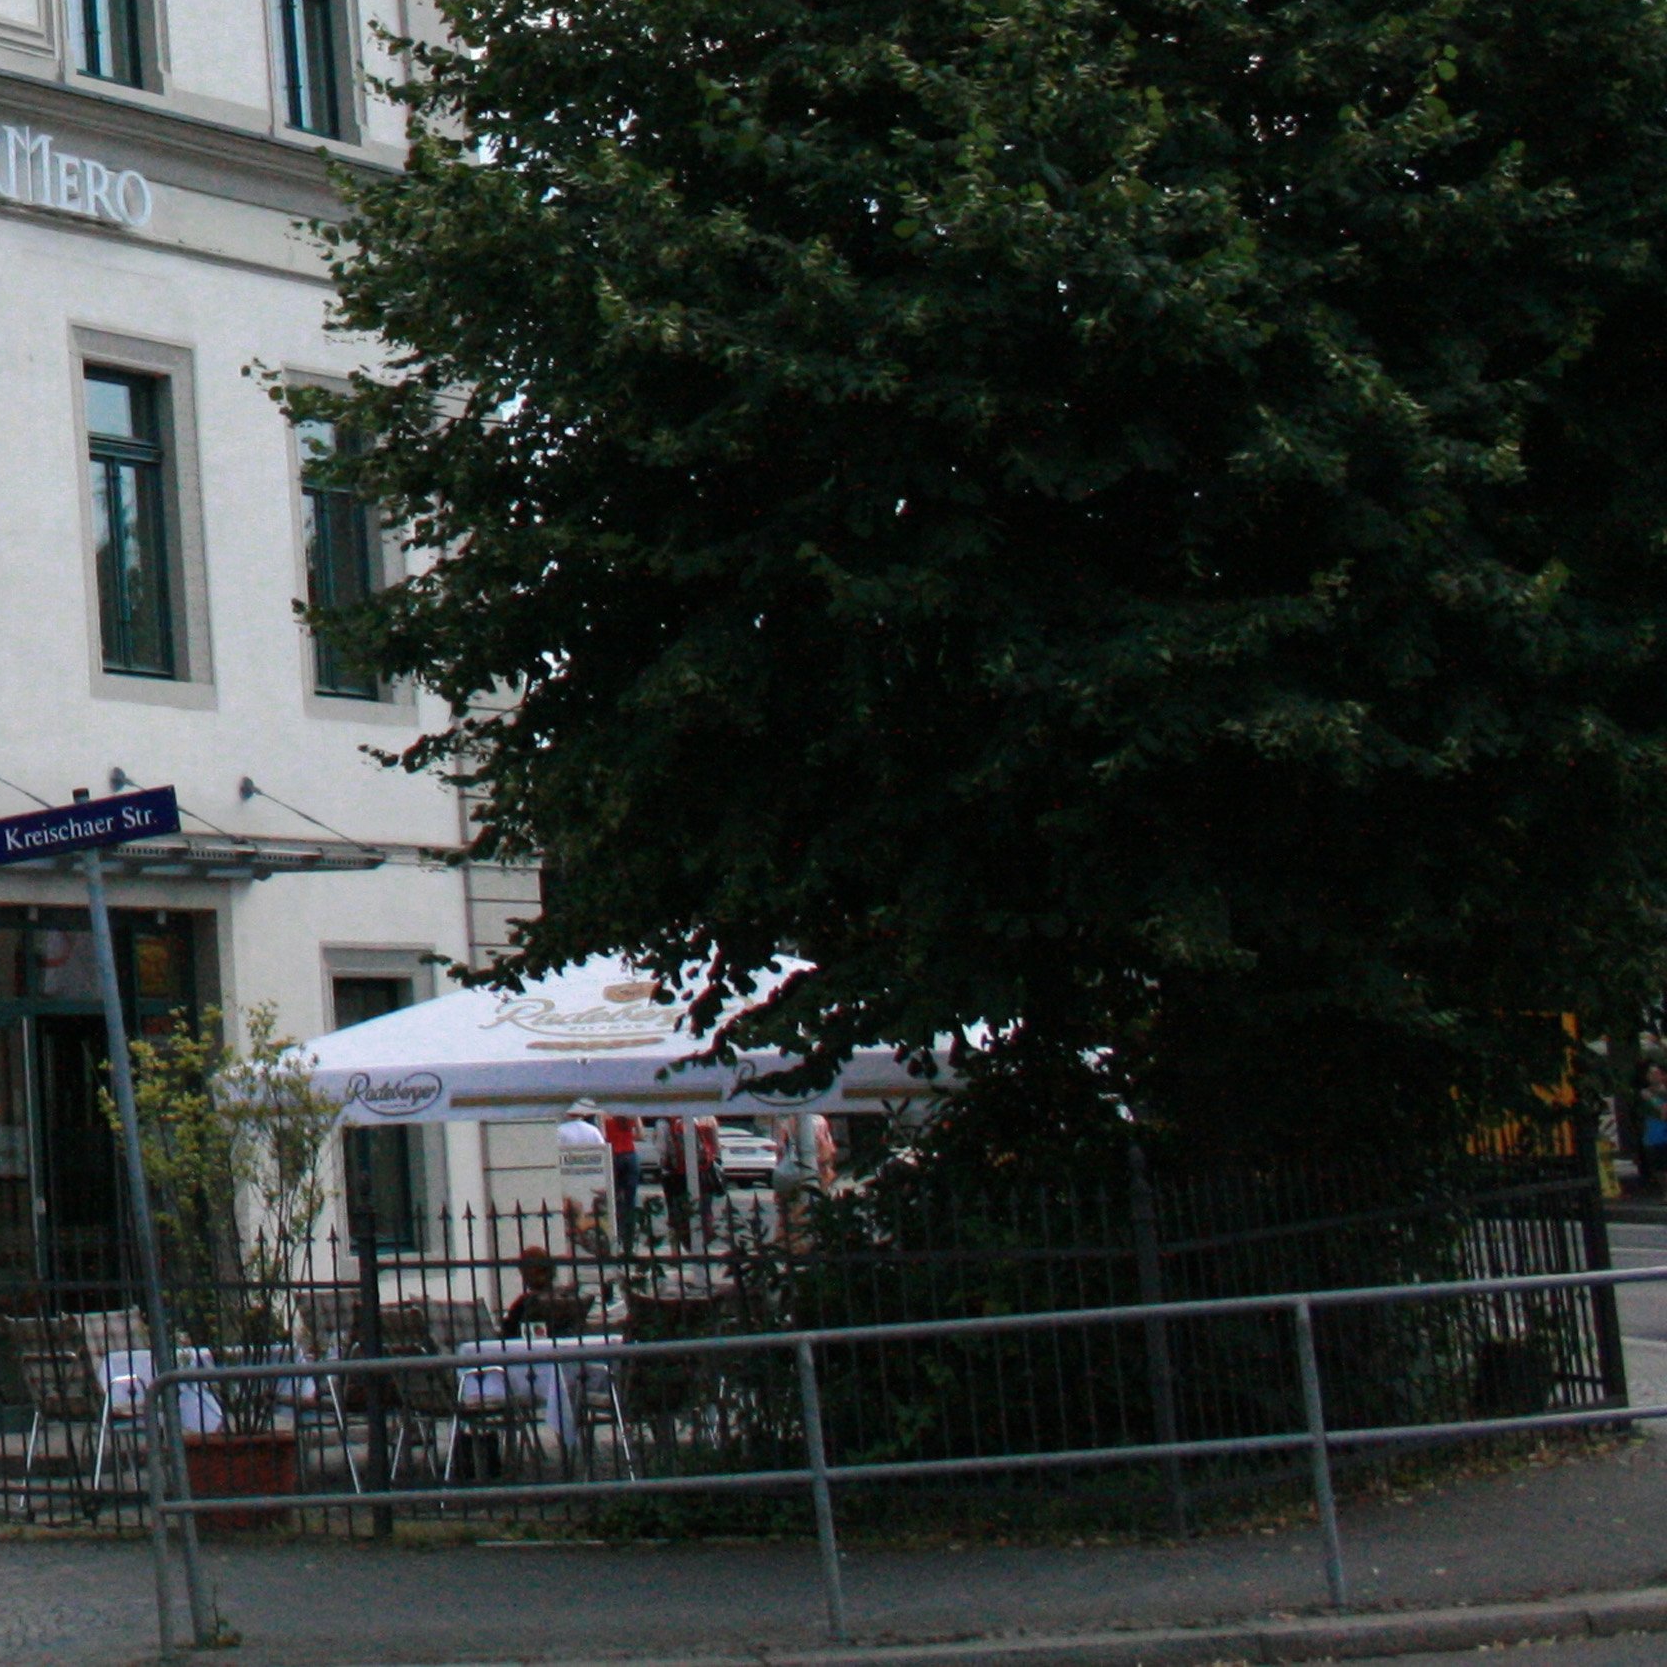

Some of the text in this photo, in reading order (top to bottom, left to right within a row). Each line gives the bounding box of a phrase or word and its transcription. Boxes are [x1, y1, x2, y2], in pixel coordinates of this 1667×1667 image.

[4, 805, 158, 852] Kreischaer Str.
[347, 1072, 442, 1115] Radeberger
